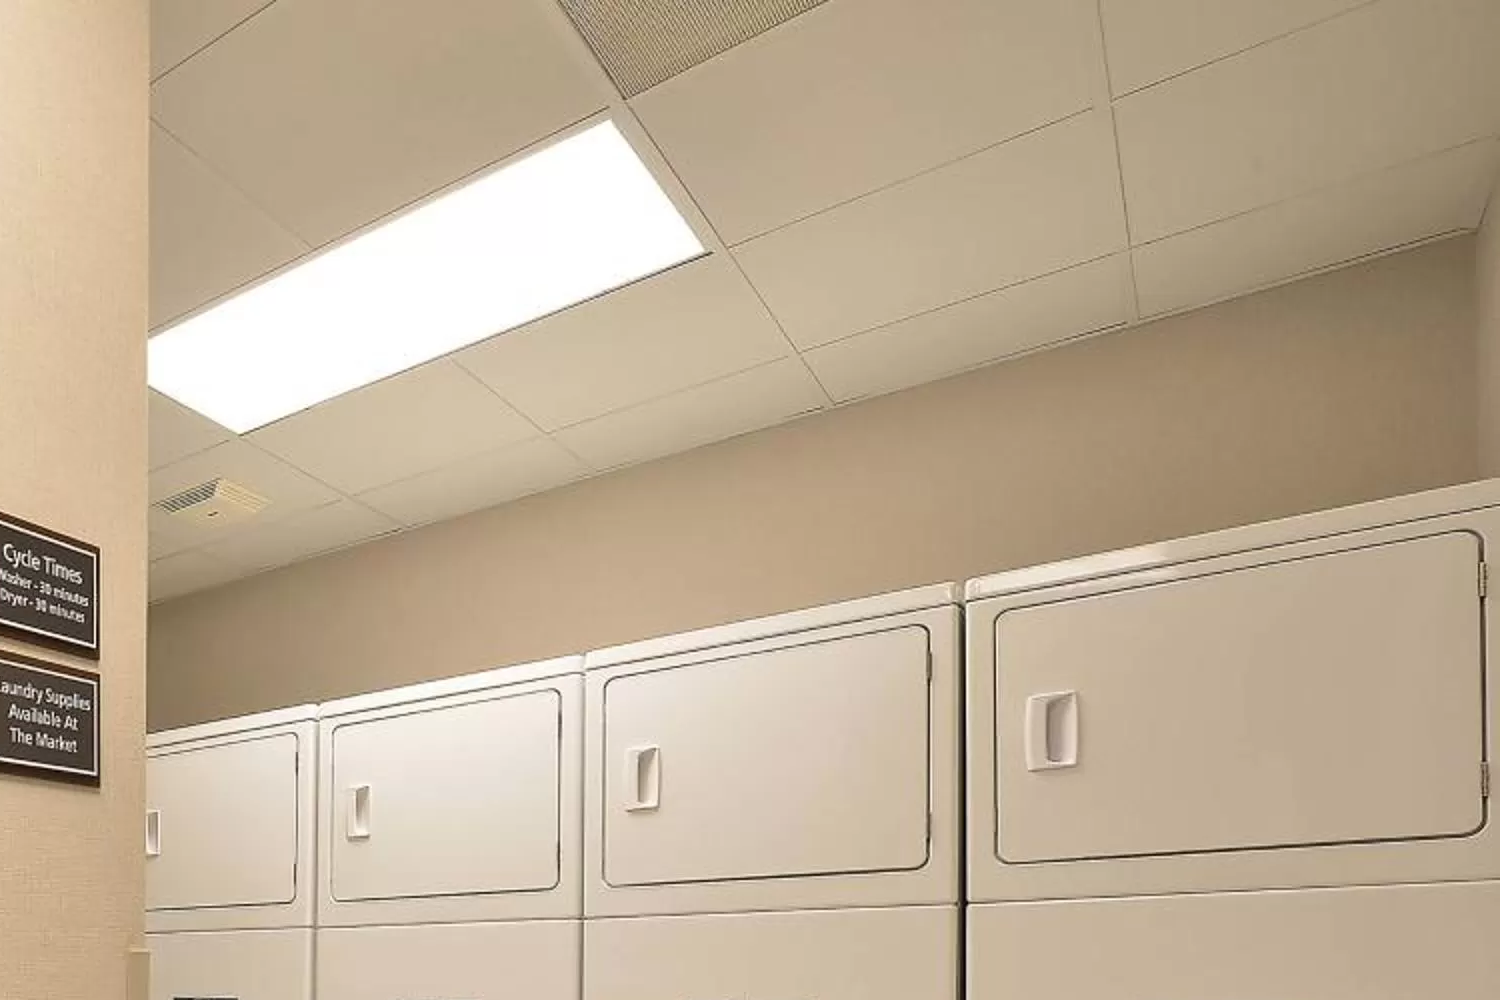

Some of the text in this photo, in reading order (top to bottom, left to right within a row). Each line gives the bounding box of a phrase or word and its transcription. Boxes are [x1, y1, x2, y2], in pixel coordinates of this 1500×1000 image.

[3, 543, 83, 585] Cycle Times
[0, 587, 28, 606] Dryer
[49, 604, 85, 623] minutes
[53, 588, 89, 607] minutes
[45, 688, 91, 711] Supplies
[8, 703, 79, 731] Available At
[9, 726, 78, 753] The Market
